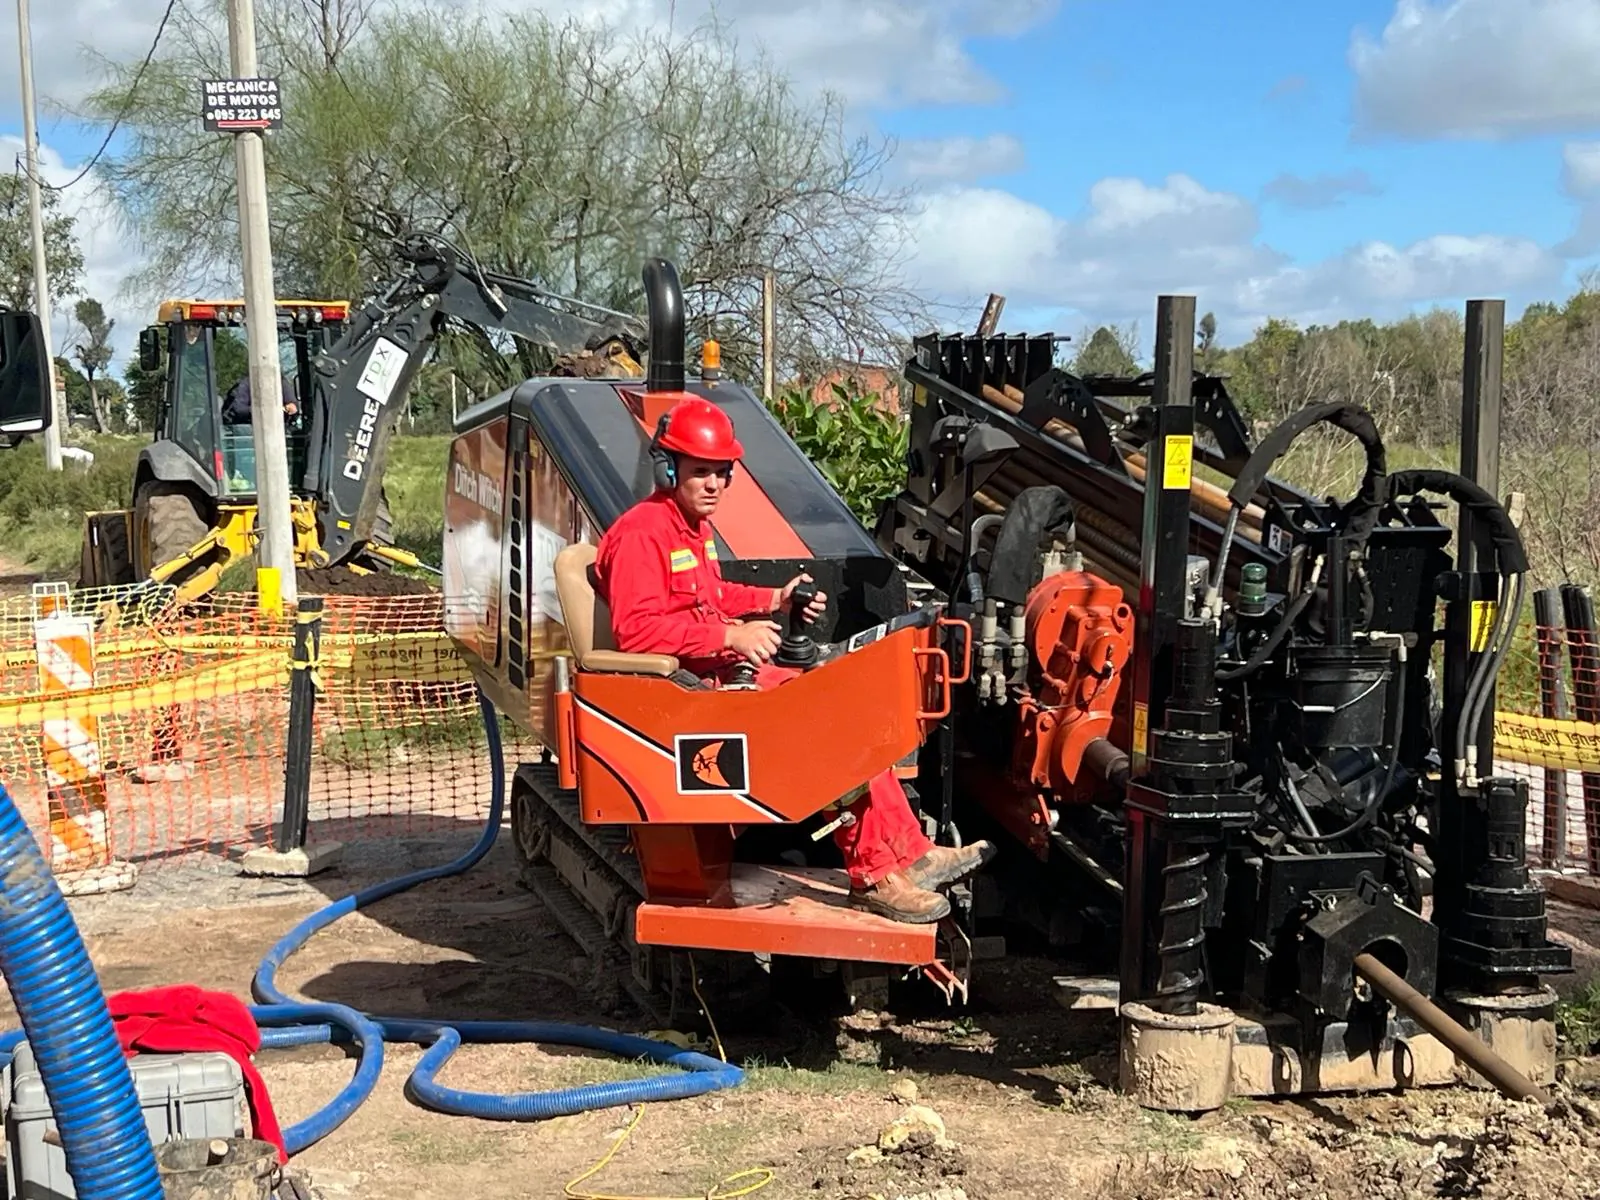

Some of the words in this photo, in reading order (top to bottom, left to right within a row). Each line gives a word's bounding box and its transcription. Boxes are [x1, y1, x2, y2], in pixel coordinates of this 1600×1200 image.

[205, 81, 278, 93] MECANICA
[208, 95, 226, 106] DE
[229, 94, 277, 106] MOTOS
[237, 108, 258, 120] 223
[362, 345, 389, 387] TDX
[343, 398, 380, 481] DEERE
[455, 463, 477, 503] Ditch
